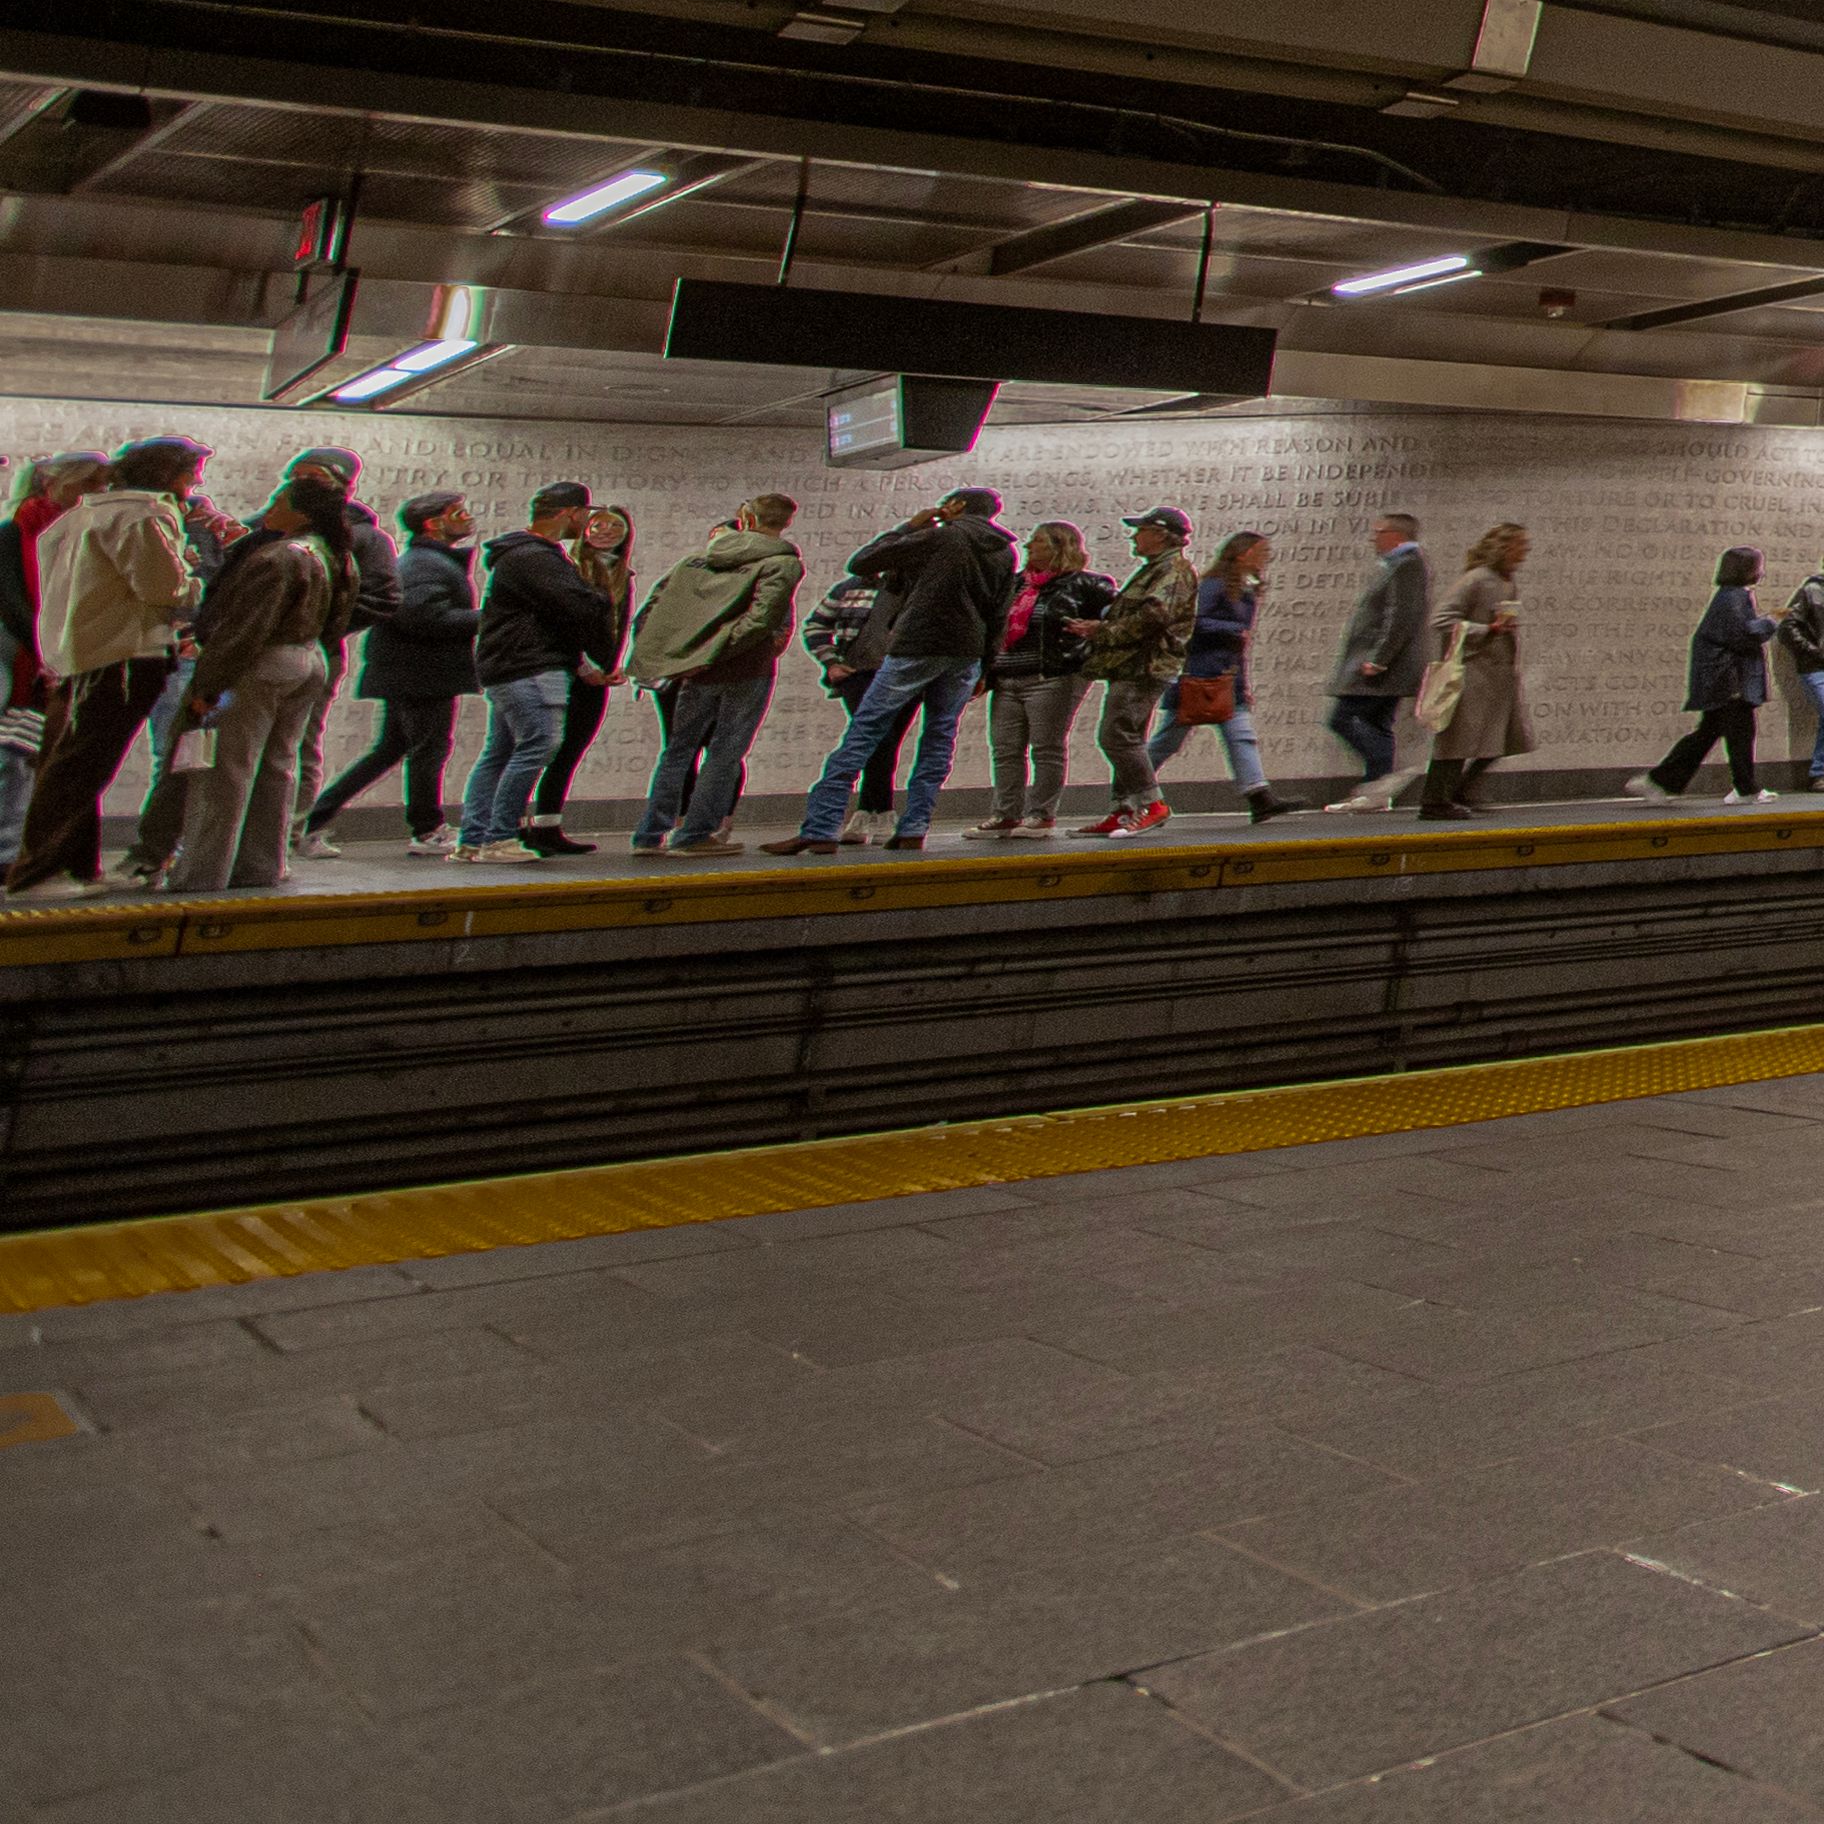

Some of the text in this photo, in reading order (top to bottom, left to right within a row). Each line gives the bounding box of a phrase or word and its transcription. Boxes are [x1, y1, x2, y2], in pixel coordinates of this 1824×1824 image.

[564, 442, 598, 463] IN
[1256, 434, 1354, 456] REASON
[1361, 433, 1422, 453] AND
[1261, 464, 1289, 482] BE
[1296, 491, 1323, 508] BE
